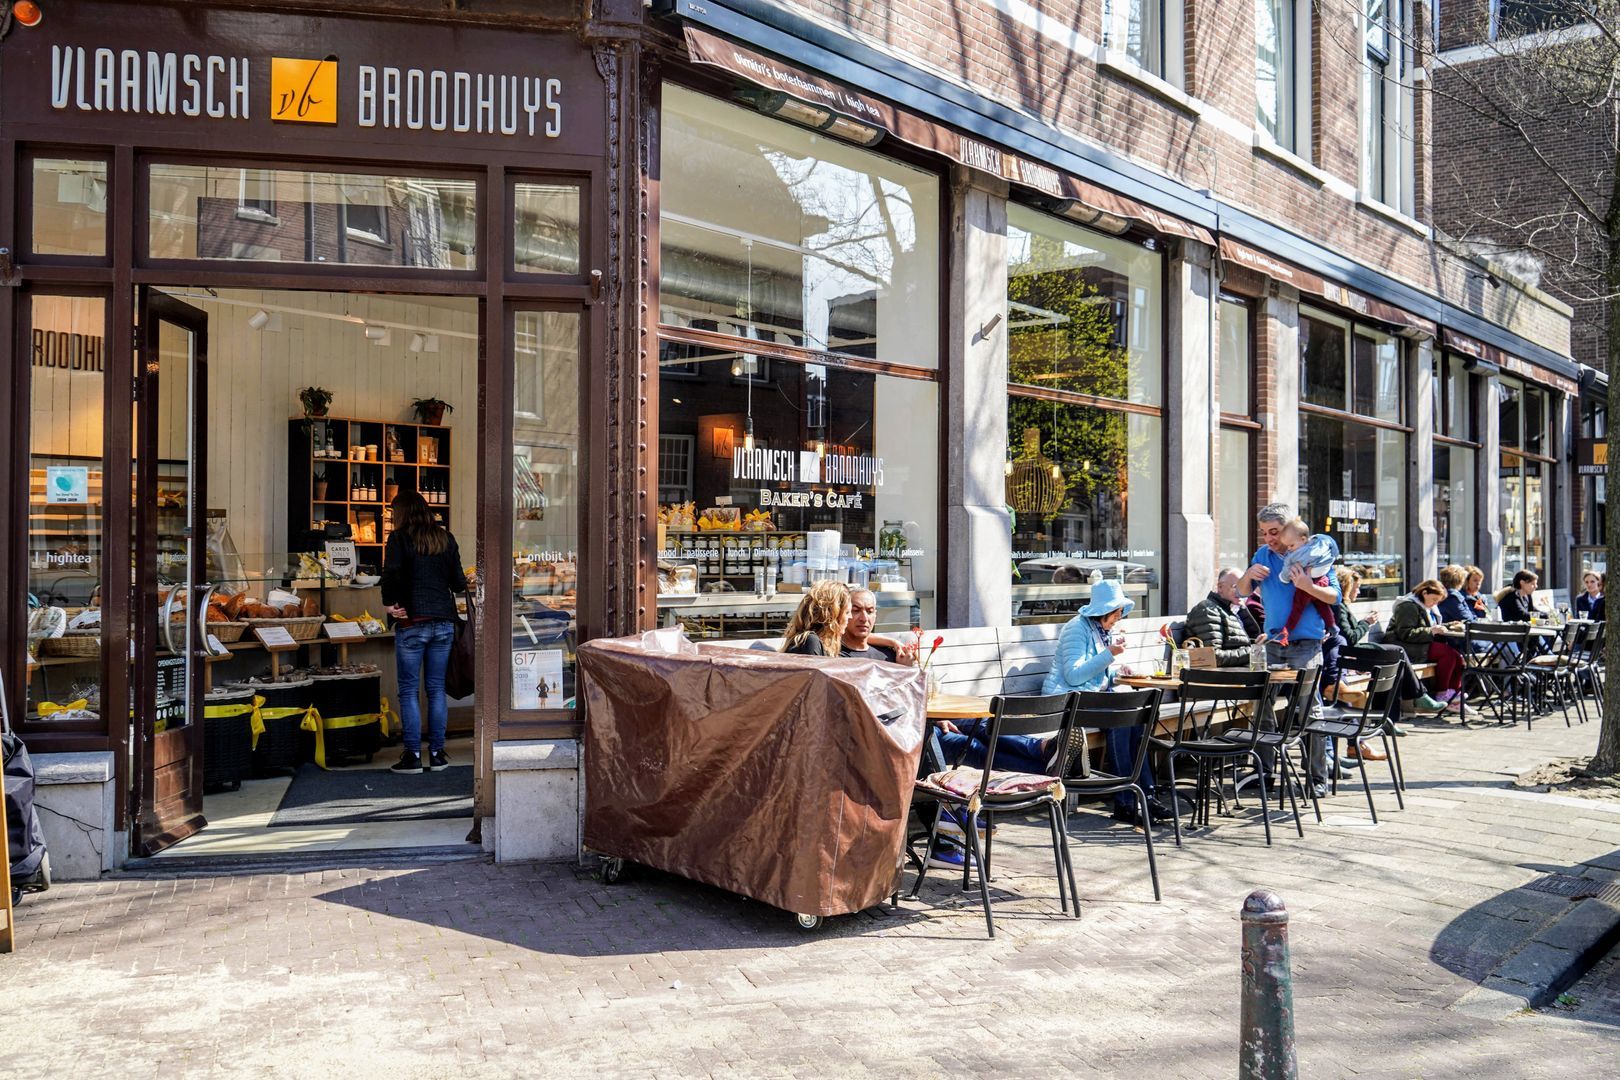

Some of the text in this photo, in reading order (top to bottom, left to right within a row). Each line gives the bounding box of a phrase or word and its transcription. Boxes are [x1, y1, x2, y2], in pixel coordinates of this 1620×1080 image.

[50, 44, 251, 120] VLAAMSCH
[358, 65, 562, 138] BROODHUYS
[733, 52, 773, 78] Dimitri's
[772, 66, 836, 101] boterhammen
[845, 94, 866, 113] high
[959, 136, 1002, 175] VLAAMSCH
[733, 446, 795, 481] VLAAMSCH
[825, 453, 884, 486] BROODHUYS
[46, 551, 92, 566] hightea
[527, 551, 564, 565] ontbijt
[686, 547, 719, 560] patisserie
[753, 547, 779, 557] Dimitri's
